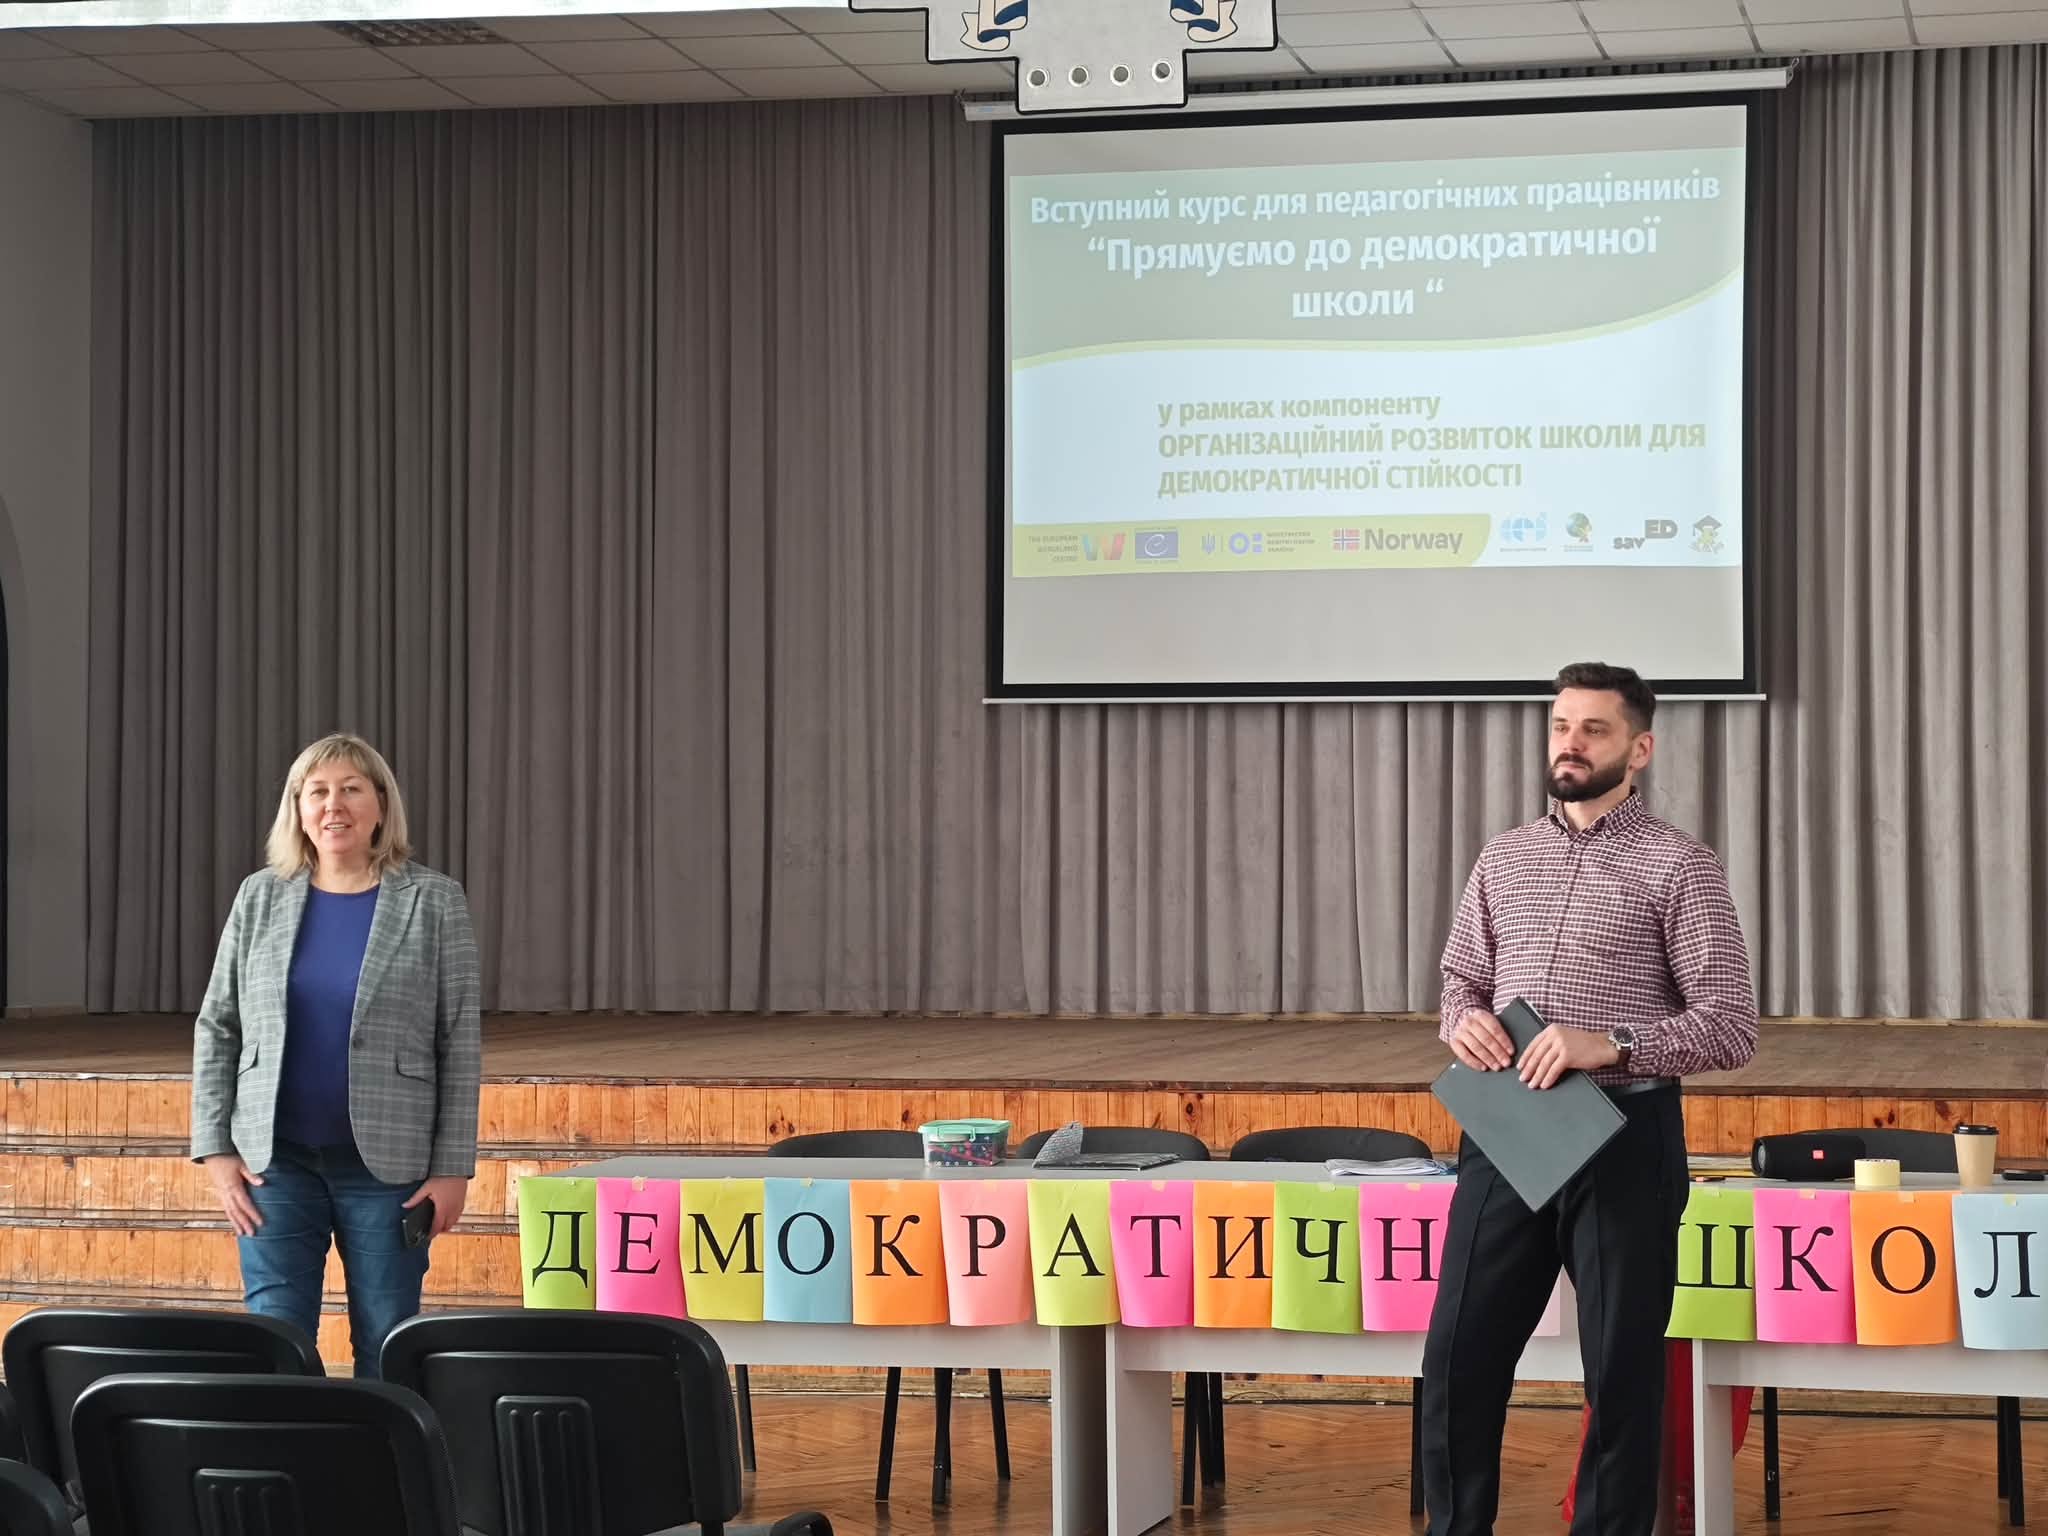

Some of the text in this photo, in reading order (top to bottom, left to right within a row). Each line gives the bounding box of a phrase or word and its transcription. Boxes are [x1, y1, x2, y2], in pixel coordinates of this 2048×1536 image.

[1031, 168, 1721, 229] Вступний курс для педагогічних працівників
[1305, 238, 1350, 272] до
[1360, 216, 1662, 270] демократичної
[1292, 289, 1415, 319] школи
[1158, 396, 1441, 428] у рамках компоненту
[1158, 423, 1706, 458] ОРГАНІЗАЦІЙНИЙ РОЗВИТОК ШКОЛИ ДЛЯ
[1158, 458, 1522, 499] ДЕМОКРАТИЧНОЇ СТІЙКОСТІ
[1364, 528, 1464, 554] Norway
[532, 1211, 1440, 1289] ДЕМОКРАТИЧН
